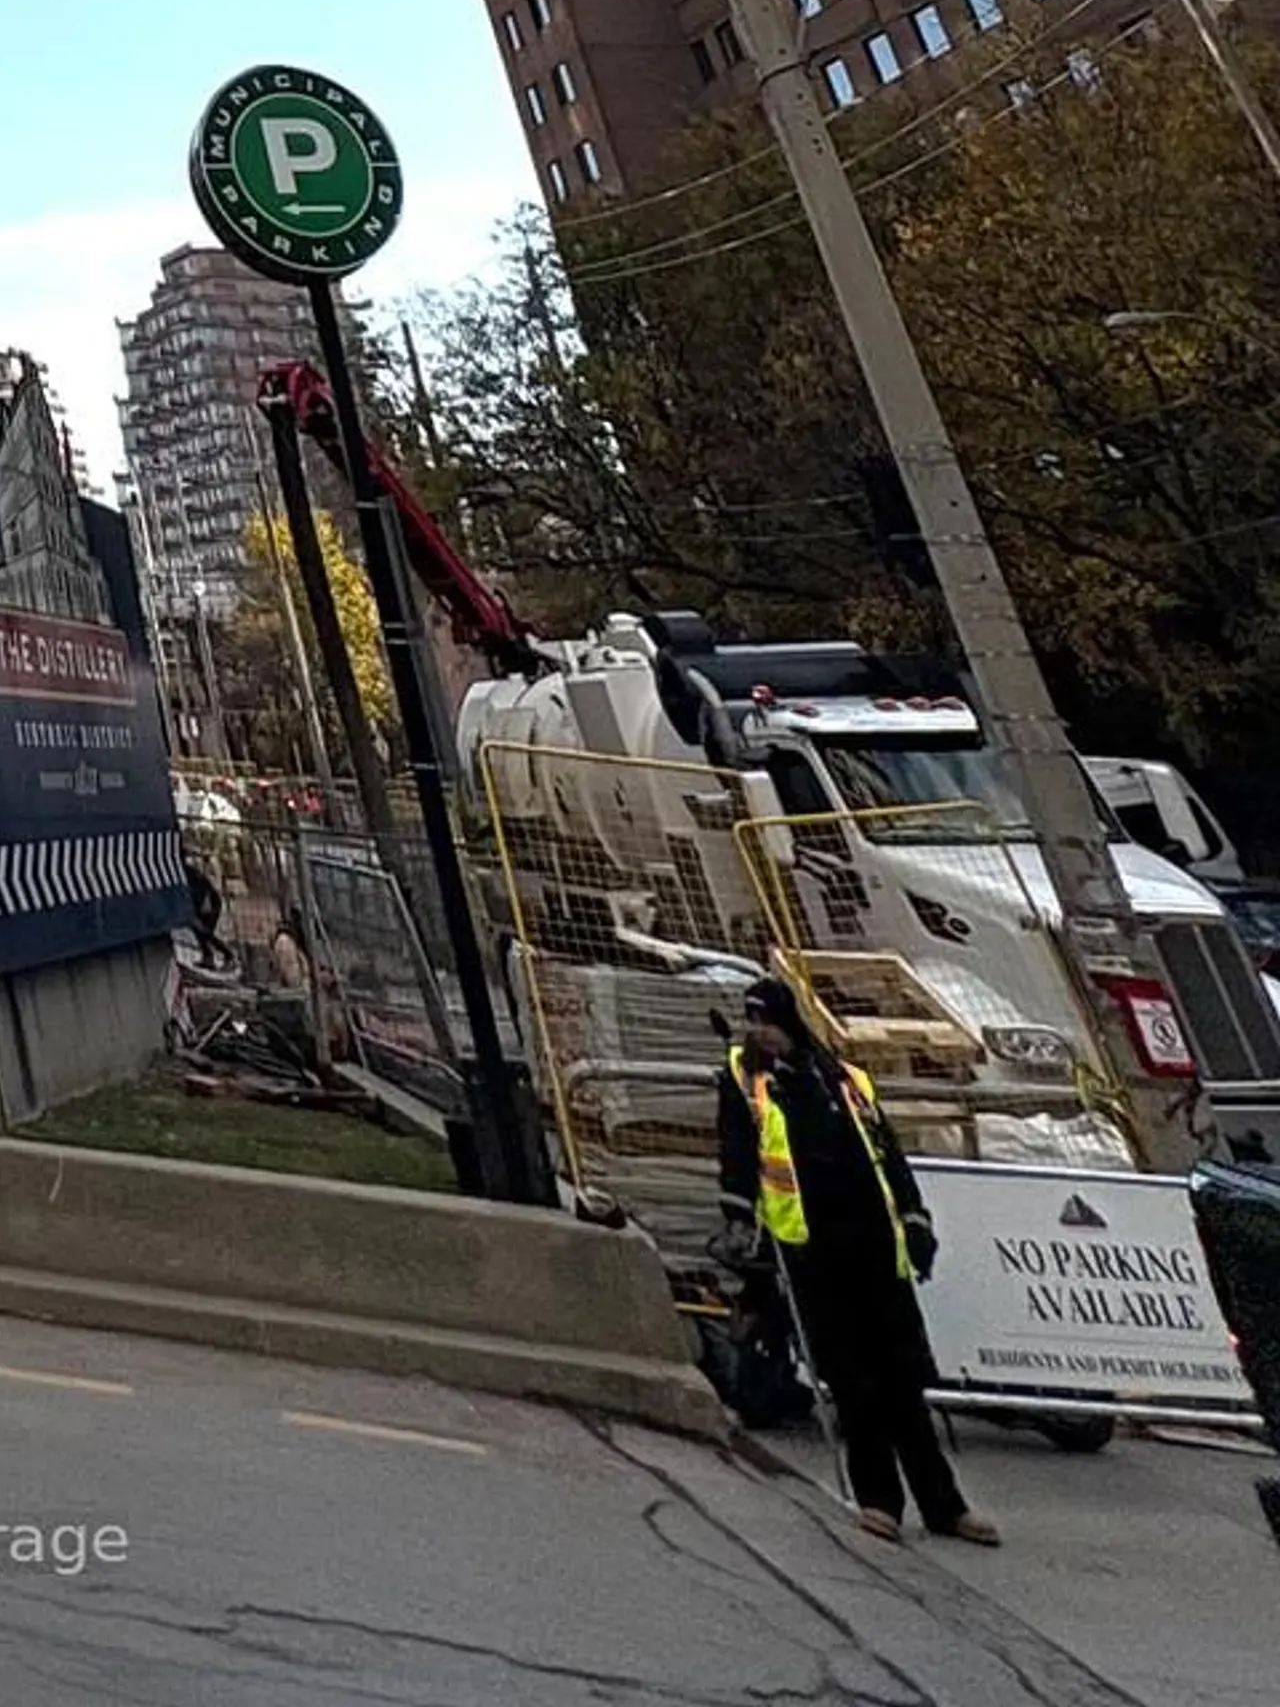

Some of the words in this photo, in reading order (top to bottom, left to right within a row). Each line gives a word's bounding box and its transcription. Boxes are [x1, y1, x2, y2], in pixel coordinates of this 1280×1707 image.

[210, 74, 382, 159] MUNICIPAL
[259, 117, 338, 195] P
[221, 183, 394, 262] PARKING
[36, 635, 128, 685] DISTILLERY
[993, 1237, 1045, 1276] NO
[1049, 1240, 1199, 1286] PARKING
[1026, 1285, 1204, 1332] AVAILABLE
